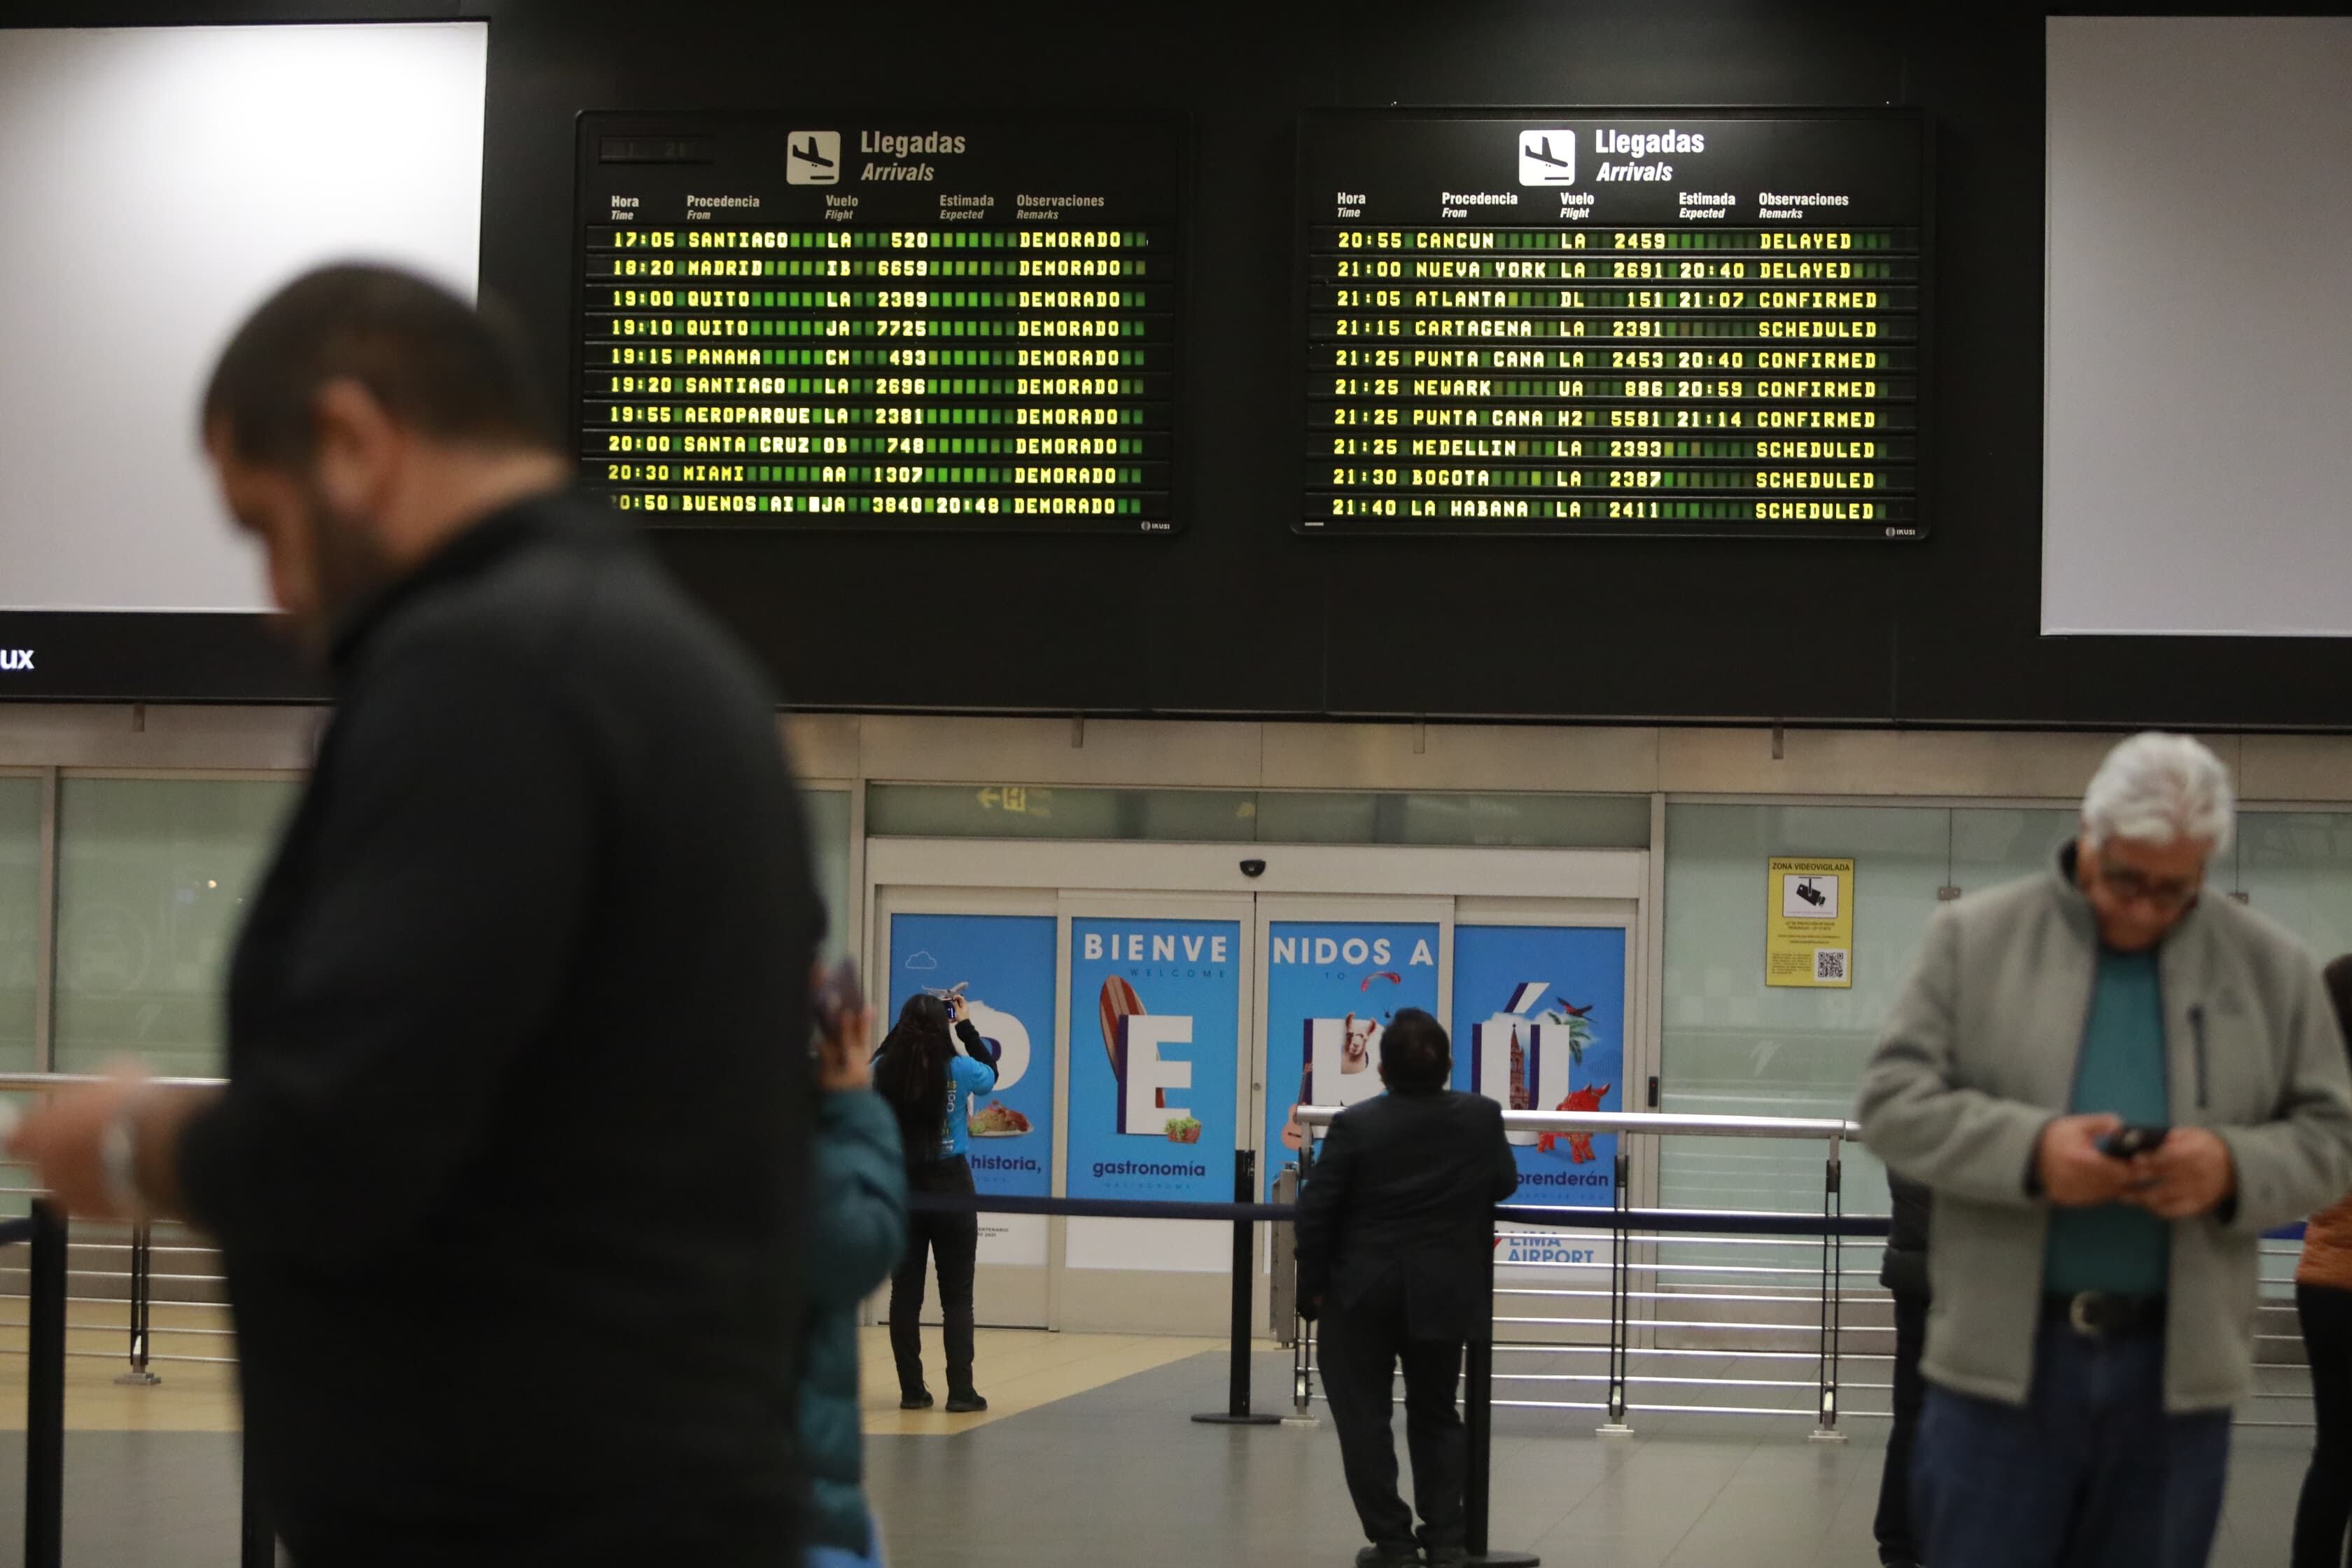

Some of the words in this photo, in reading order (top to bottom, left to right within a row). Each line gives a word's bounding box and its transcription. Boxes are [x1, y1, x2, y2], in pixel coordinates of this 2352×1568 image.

[861, 130, 966, 158] Llegadas
[1595, 129, 1704, 158] Llegadas
[861, 162, 934, 182] Arrivals
[1596, 162, 1673, 182] Arrivals
[612, 195, 639, 208] Hora
[687, 195, 760, 207] Procedencia
[825, 195, 859, 207] Vuelo
[940, 195, 994, 206] Estimada
[1017, 195, 1105, 207] Observaciones
[1338, 192, 1366, 205] Hora
[1442, 192, 1518, 205] Procedencia
[1560, 192, 1595, 205] Vuelo
[1679, 192, 1736, 206] Estimada
[1759, 192, 1849, 206] Observaciones
[612, 211, 634, 220] Time
[687, 210, 711, 220] From
[825, 210, 853, 222] Flight
[939, 210, 984, 221] Expected
[1017, 210, 1059, 220] Remarks
[1338, 208, 1361, 218] Time
[1442, 208, 1468, 218] From
[1560, 208, 1590, 220] Flight
[1679, 208, 1726, 220] Expected
[1759, 208, 1803, 219] Remarks
[615, 232, 673, 247] 17:05
[690, 232, 788, 248] SANTIAGO
[828, 232, 850, 248] LA
[892, 232, 927, 247] 520
[1021, 232, 1120, 247] DEMORADO
[1339, 232, 1401, 248] 20:55
[1418, 233, 1493, 248] CANCUN
[1562, 233, 1585, 248] LA
[1615, 234, 1665, 249] 2459
[1760, 234, 1850, 249] DELAYED
[615, 260, 673, 275] 18:20
[689, 260, 762, 275] MADRID
[827, 261, 850, 276] IB
[878, 261, 927, 276] 6659
[1019, 260, 1119, 275] DEMORADO
[1338, 262, 1400, 276] 21:00
[1417, 262, 1479, 277] NUEVA
[1496, 262, 1545, 278] YORK
[1562, 262, 1585, 278] LA
[1614, 262, 1662, 279] 2691
[1681, 262, 1744, 279] 20:40
[1760, 263, 1850, 279] DELAYED
[614, 291, 673, 307] 19:00
[688, 291, 749, 307] QUITO
[827, 292, 850, 307] LA
[878, 292, 927, 307] 2389
[1020, 292, 1119, 307] DEMORADO
[1338, 291, 1399, 307] 21:05
[1416, 291, 1506, 307] ATLANTA
[1561, 292, 1583, 307] DL
[1628, 292, 1661, 308] 151
[1679, 292, 1743, 308] 21:07
[1760, 293, 1876, 307] CONFIRMED
[613, 320, 672, 335] 19:10
[687, 321, 748, 335] QUITO
[827, 321, 849, 336] JA
[878, 321, 925, 336] 7725
[1018, 321, 1118, 336] DEMORADO
[1337, 320, 1399, 335] 21:15
[1415, 321, 1531, 336] CARTAGENA
[1560, 321, 1583, 337] LA
[1614, 321, 1661, 337] 2391
[1760, 322, 1875, 337] SCHEDULED
[613, 349, 671, 364] 19:15
[687, 349, 760, 364] PANAMA
[826, 350, 848, 365] CM
[890, 350, 925, 365] 493
[1018, 351, 1118, 365] DEMORADO
[1336, 351, 1399, 366] 21:25
[1415, 351, 1478, 366] PUNTA
[1494, 351, 1544, 367] CANA
[1560, 352, 1583, 368] LA
[1613, 352, 1662, 368] 2453
[1679, 352, 1742, 368] 20:40
[1759, 353, 1875, 368] CONFIRMED
[612, 377, 671, 393] 19:20
[687, 378, 785, 393] SANTIAGO
[825, 379, 848, 393] LA
[876, 379, 925, 394] 2696
[1018, 379, 1117, 394] DEMORADO
[1336, 379, 1398, 395] 21:25
[1415, 380, 1490, 396] NEWARK
[1560, 381, 1583, 396] UA
[1625, 382, 1662, 397] 886
[1679, 382, 1742, 397] 20:59
[1758, 382, 1875, 397] CONFIRMED
[612, 407, 670, 422] 19:55
[686, 407, 809, 424] AEROPARQUE
[825, 408, 848, 424] LA
[876, 409, 922, 424] 2381
[1017, 409, 1117, 424] DEMORADO
[1335, 410, 1397, 424] 21:25
[1414, 410, 1476, 426] PUNTA
[1492, 410, 1542, 426] CANA
[1559, 411, 1582, 426] H2
[1611, 412, 1659, 427] 5581
[1678, 412, 1741, 427] 21:14
[1758, 412, 1874, 427] CONFIRMED
[609, 436, 669, 451] 20:00
[685, 437, 745, 451] SANTA
[760, 437, 808, 452] CRUZ
[824, 438, 846, 453] OB
[888, 438, 923, 454] 748
[1016, 439, 1116, 454] DEMORADO
[1334, 439, 1396, 454] 21:25
[1413, 440, 1516, 456] MEDELLIN
[1558, 441, 1581, 456] LA
[1611, 442, 1661, 457] 2393
[1758, 442, 1873, 458] SCHEDULED
[609, 465, 668, 480] 20:30
[684, 466, 743, 481] MIAMI
[823, 467, 846, 482] AA
[875, 468, 922, 482] 1307
[1015, 468, 1115, 483] DEMORADO
[1334, 469, 1396, 484] 21:30
[1413, 470, 1488, 486] BOGOTA
[1558, 471, 1581, 486] LA
[1611, 472, 1660, 487] 2387
[1757, 472, 1873, 488] SCHEDULED
[683, 496, 756, 511] BUENOS
[771, 496, 792, 512] AI
[822, 497, 845, 512] JA
[873, 497, 923, 512] 3840
[937, 498, 998, 513] 20:48
[1014, 498, 1114, 513] DEMORADO
[1333, 500, 1395, 515] 21:40
[1412, 500, 1435, 515] LA
[1451, 500, 1527, 517] HABANA
[1557, 502, 1580, 517] LA
[1610, 502, 1657, 518] 2411
[1756, 503, 1872, 519] SCHEDULED
[1085, 934, 1226, 962] BIENVE
[1273, 938, 1391, 965] NIDOS
[1409, 939, 1434, 965] A
[1130, 968, 1224, 978] WELCOME
[972, 1155, 1042, 1174] historia,
[1093, 1161, 1205, 1177] gastronomía
[1508, 1249, 1595, 1263] AIRPORT
